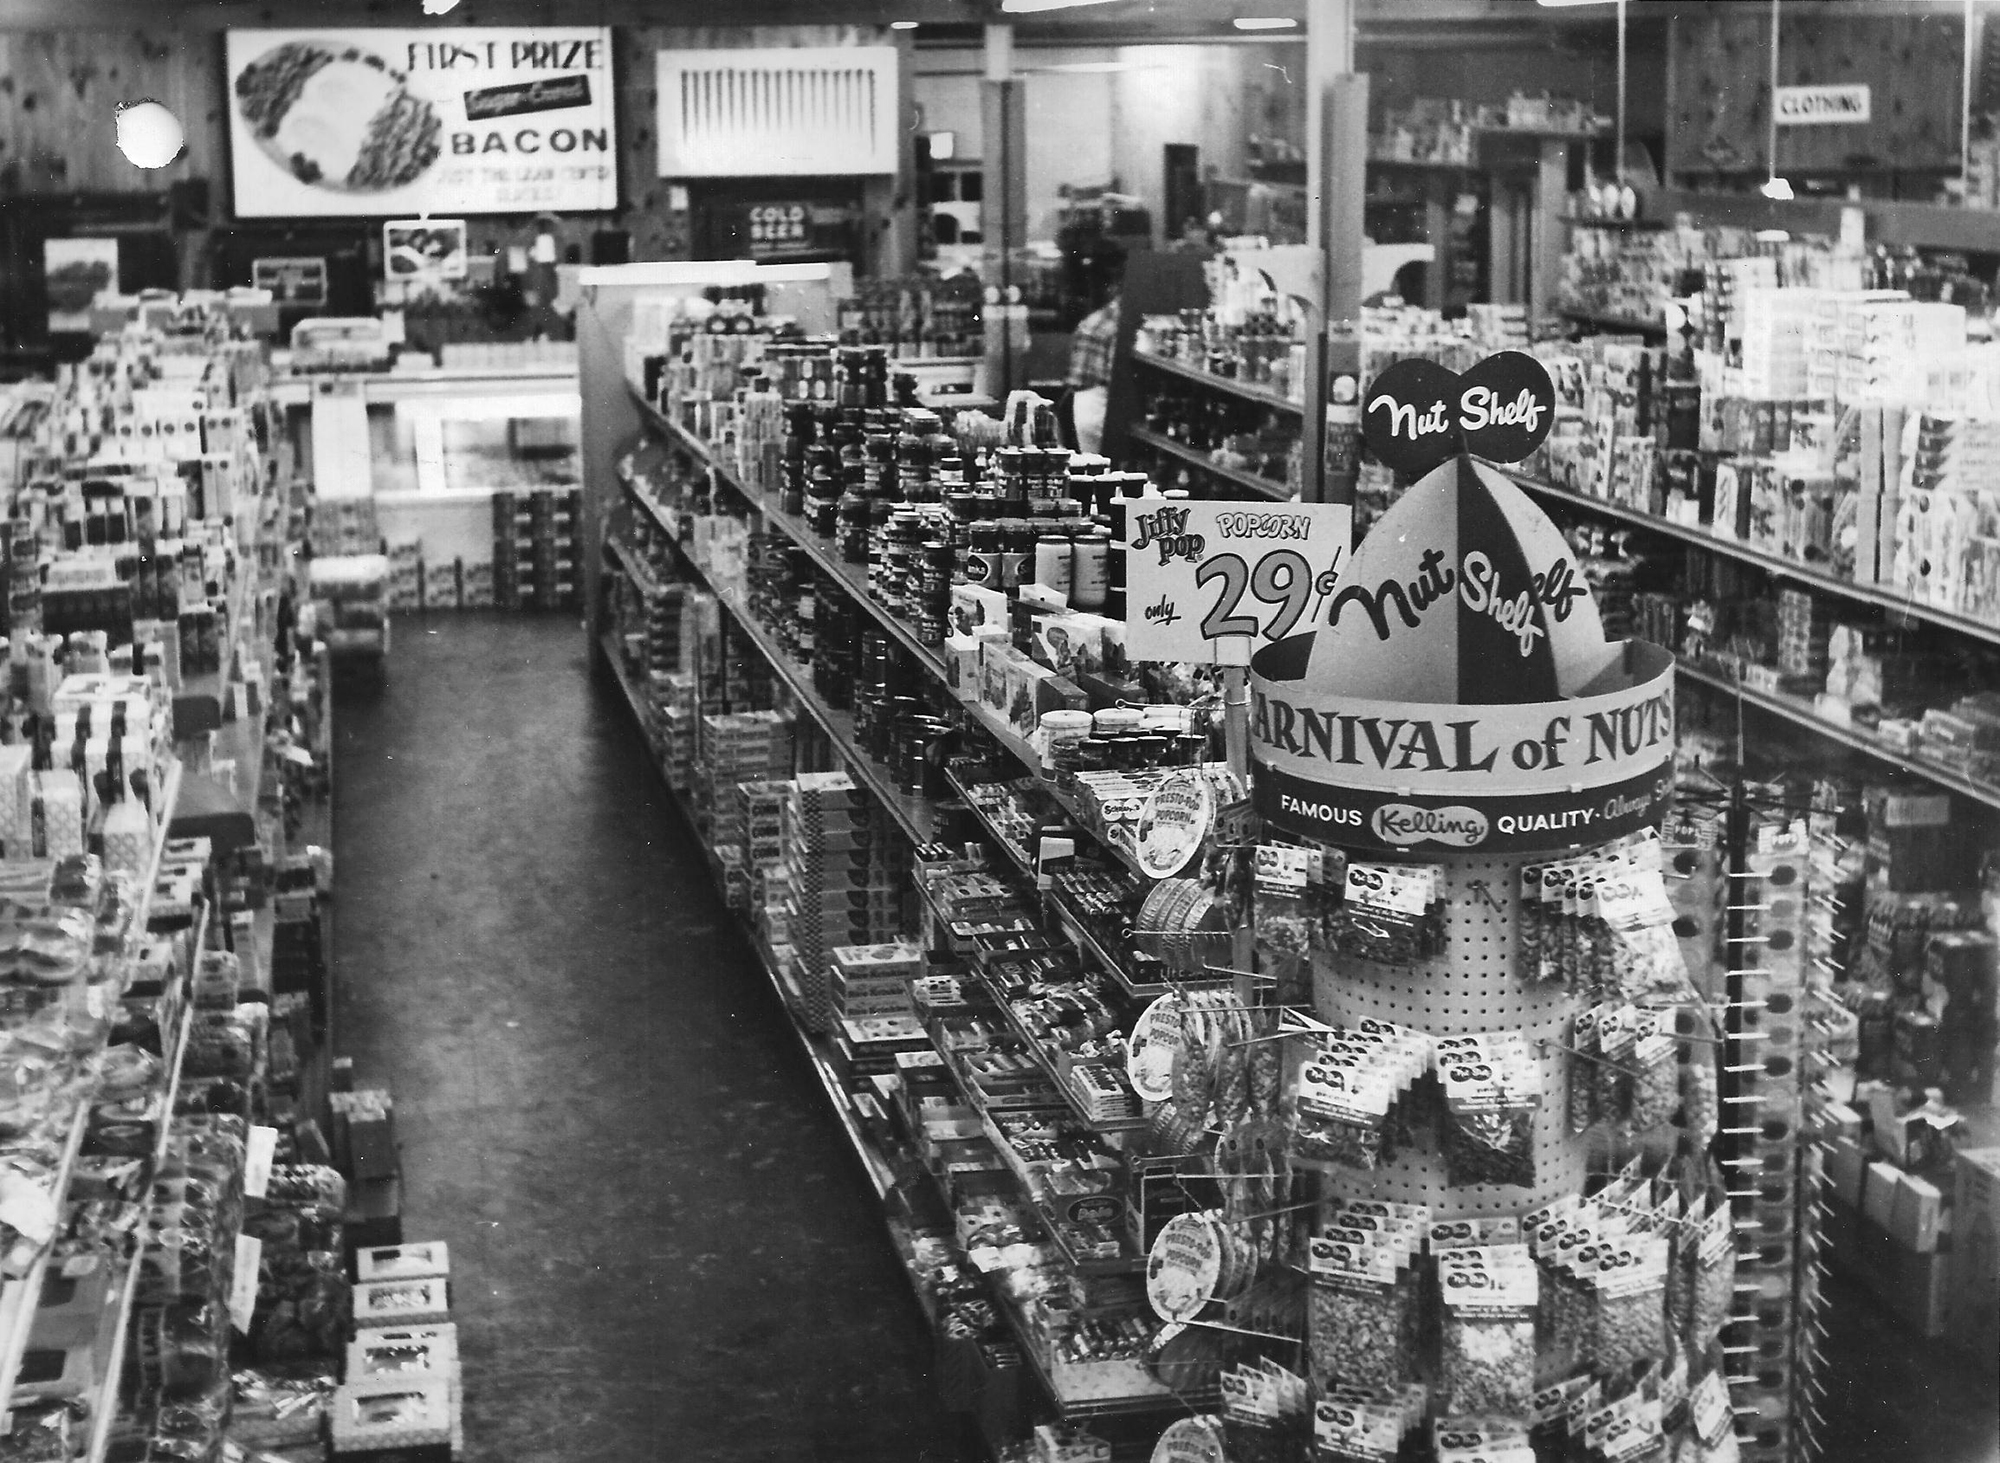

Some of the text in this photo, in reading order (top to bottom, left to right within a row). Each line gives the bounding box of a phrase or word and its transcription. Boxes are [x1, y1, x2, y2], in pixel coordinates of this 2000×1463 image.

[408, 39, 604, 71] FIRST PRIZE
[1781, 95, 1862, 114] CLOTHING
[452, 127, 608, 155] BACON
[749, 206, 804, 222] COLD
[750, 223, 804, 239] BEER
[1368, 386, 1547, 441] Nut Shelf
[1131, 507, 1191, 549] Jiffy
[1216, 512, 1311, 540] POPCORN
[1158, 534, 1206, 566] pop
[1196, 546, 1342, 641] 29¢
[1329, 549, 1544, 657] Nut Shelf
[1144, 594, 1181, 626] only
[1252, 692, 1500, 773] ARNIVAL
[1511, 715, 1571, 770] of
[1281, 796, 1363, 826] FAMOUS
[1379, 807, 1483, 845] Kelling
